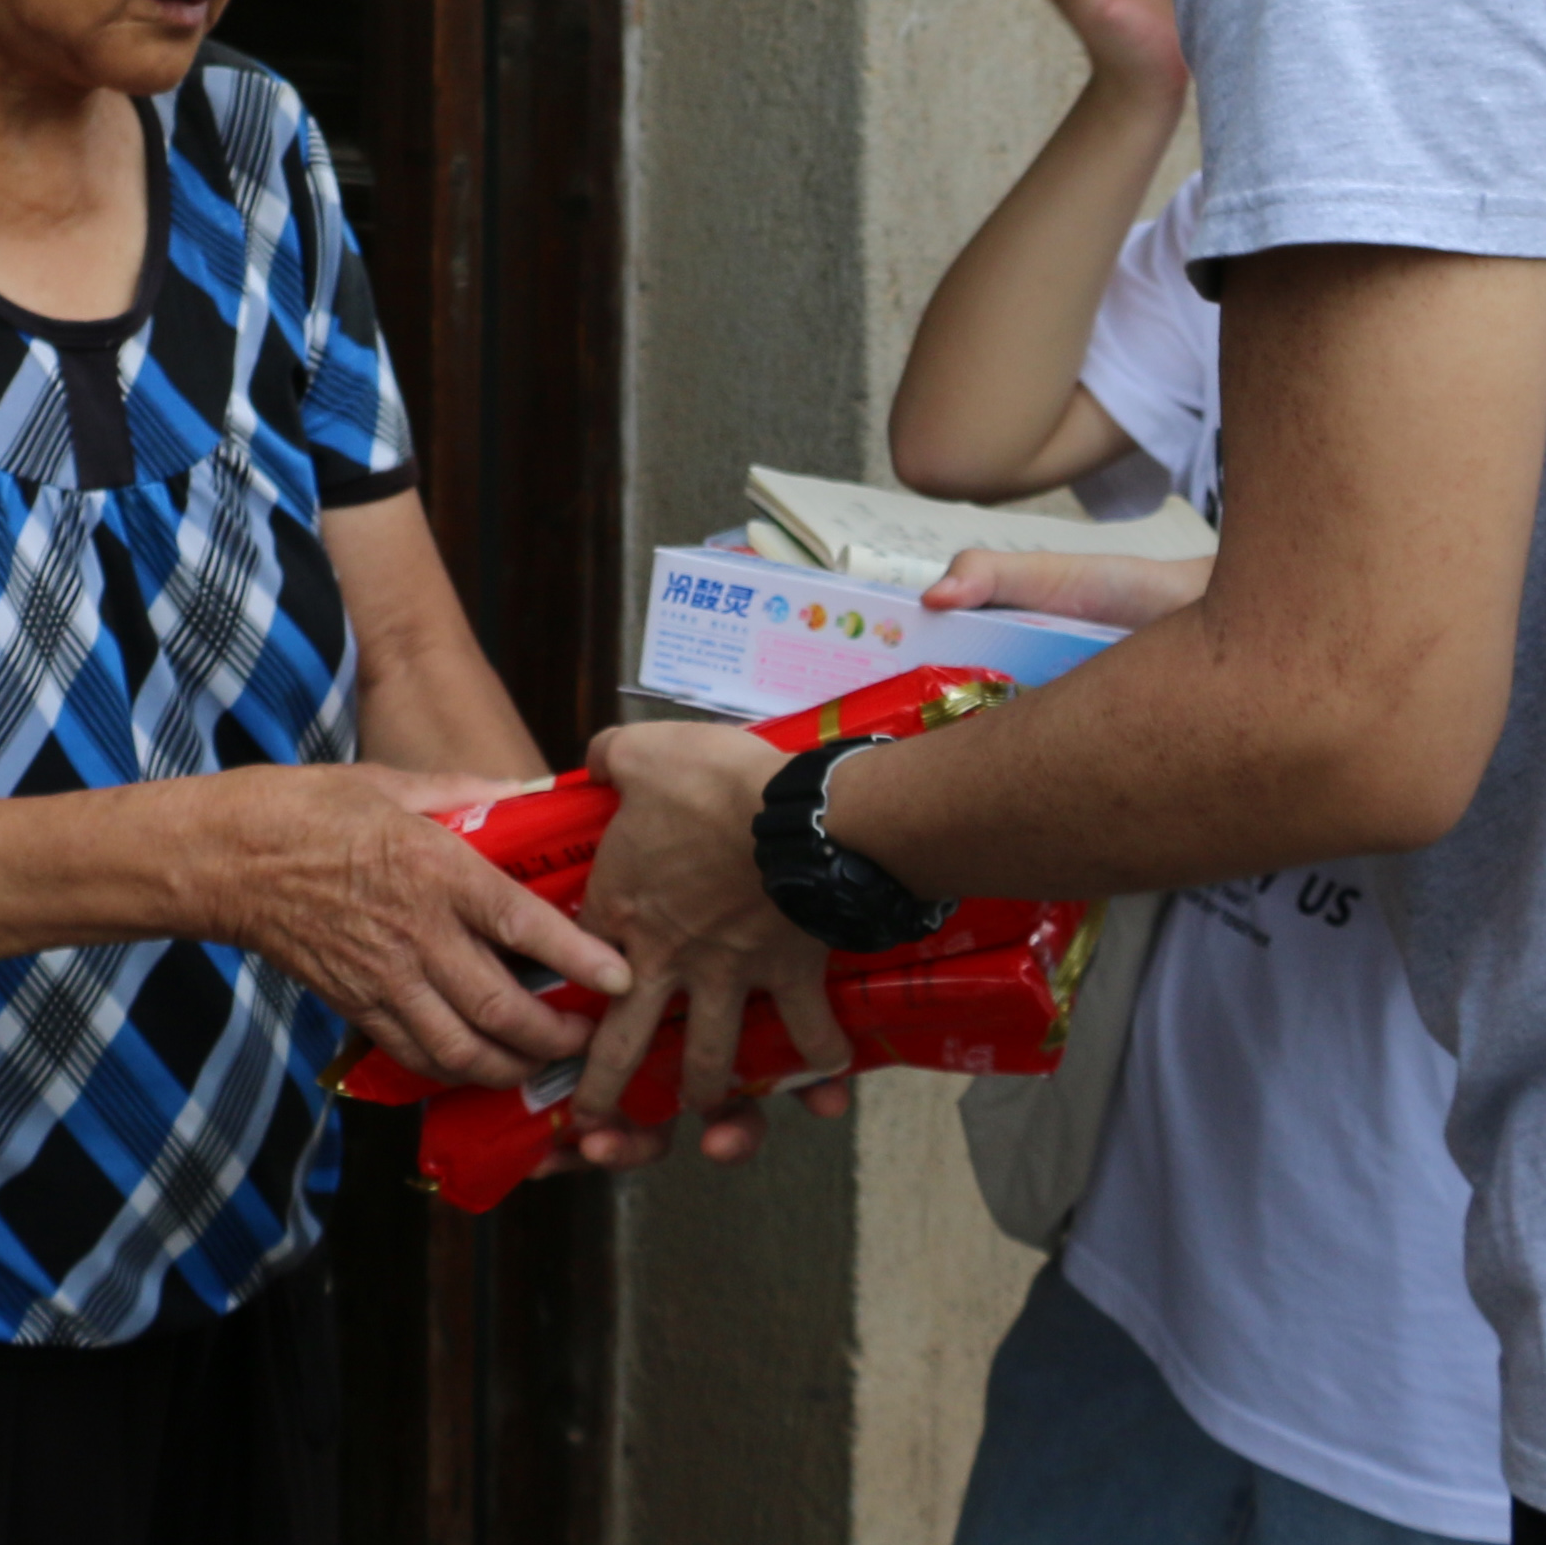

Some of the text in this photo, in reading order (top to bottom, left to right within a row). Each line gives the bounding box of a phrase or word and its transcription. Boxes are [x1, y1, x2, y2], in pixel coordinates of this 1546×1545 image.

[662, 571, 755, 618] 冷酸灵
[1297, 873, 1362, 928] US
